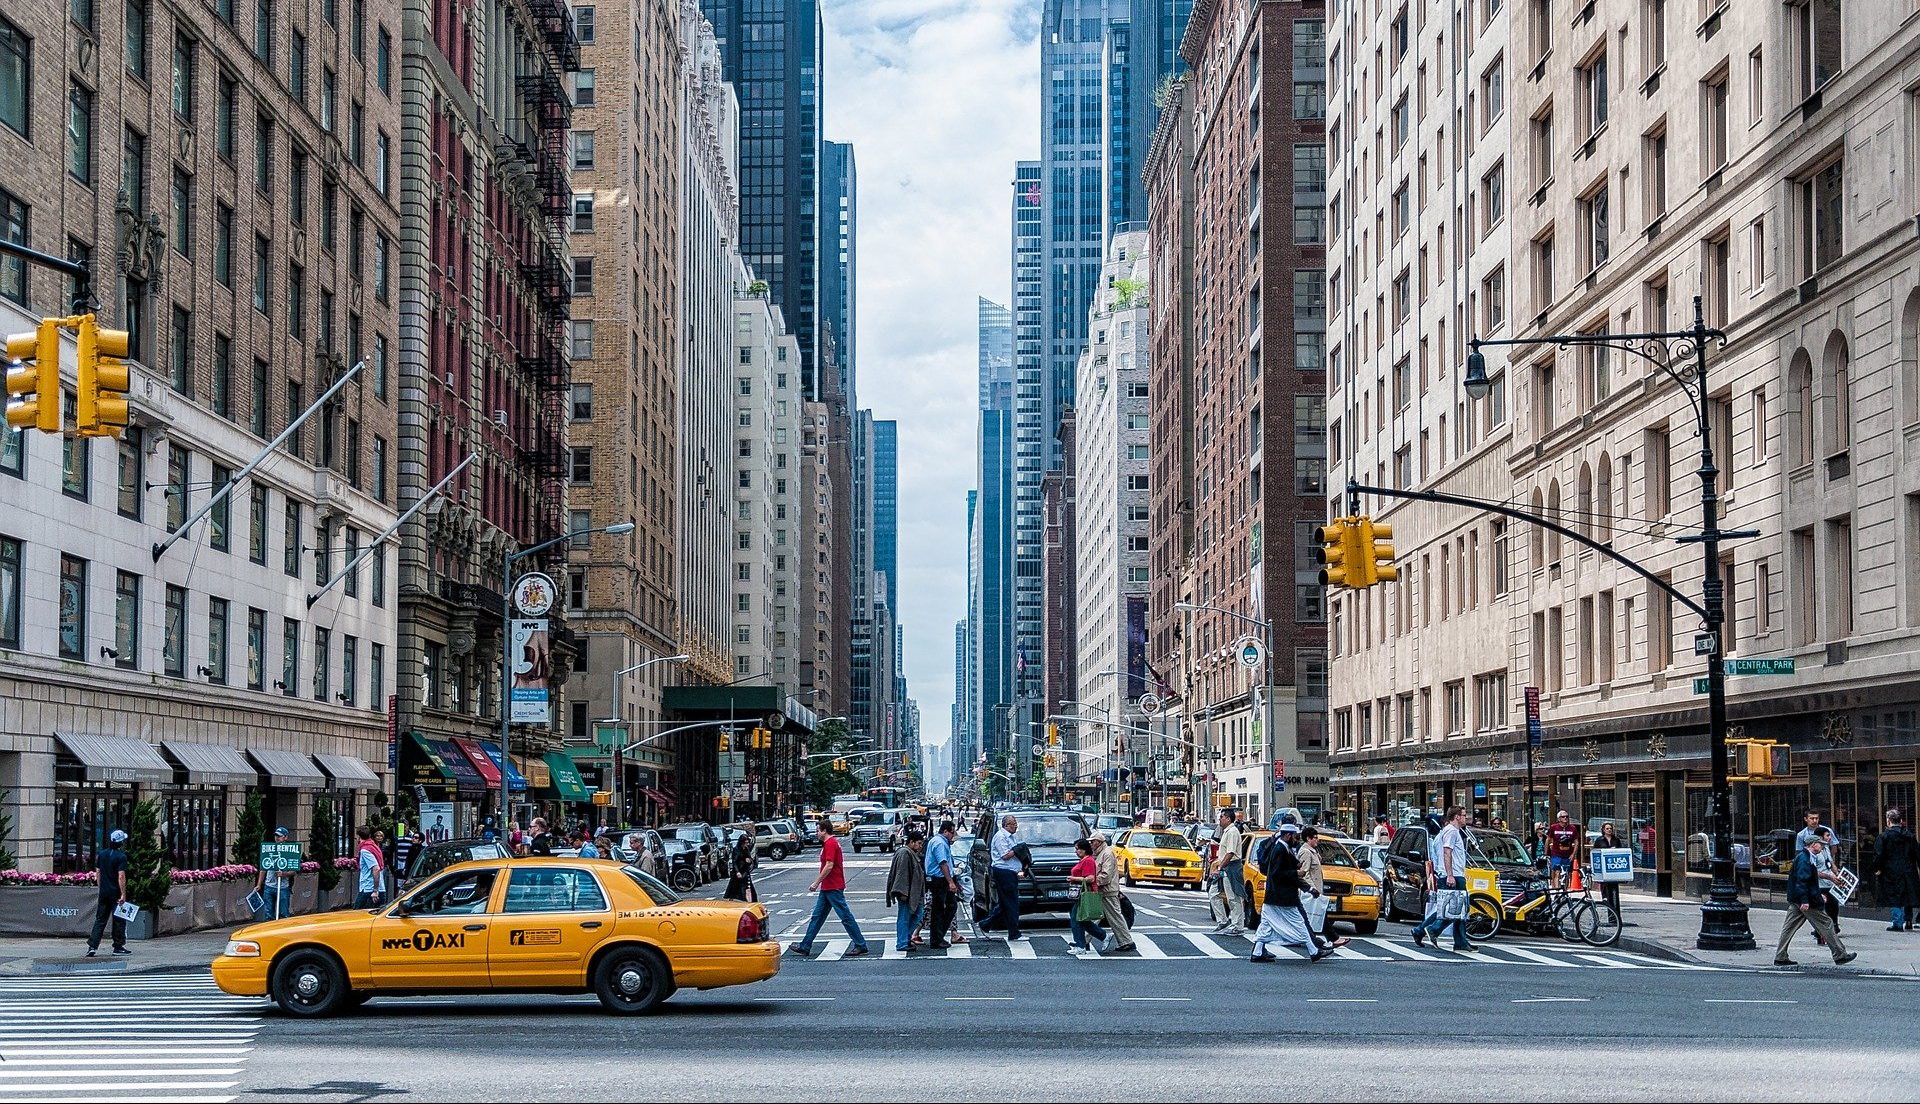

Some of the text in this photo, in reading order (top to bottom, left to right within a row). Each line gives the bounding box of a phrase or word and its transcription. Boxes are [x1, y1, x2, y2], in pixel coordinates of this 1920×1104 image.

[521, 622, 539, 630] NYC
[1737, 660, 1794, 669] CENTRAL PARK
[1701, 680, 1706, 692] 6
[113, 768, 136, 780] MARKET
[261, 844, 300, 853] BIKE RENTAL
[41, 908, 79, 916] MARKET
[382, 931, 465, 949] NYC TAXI
